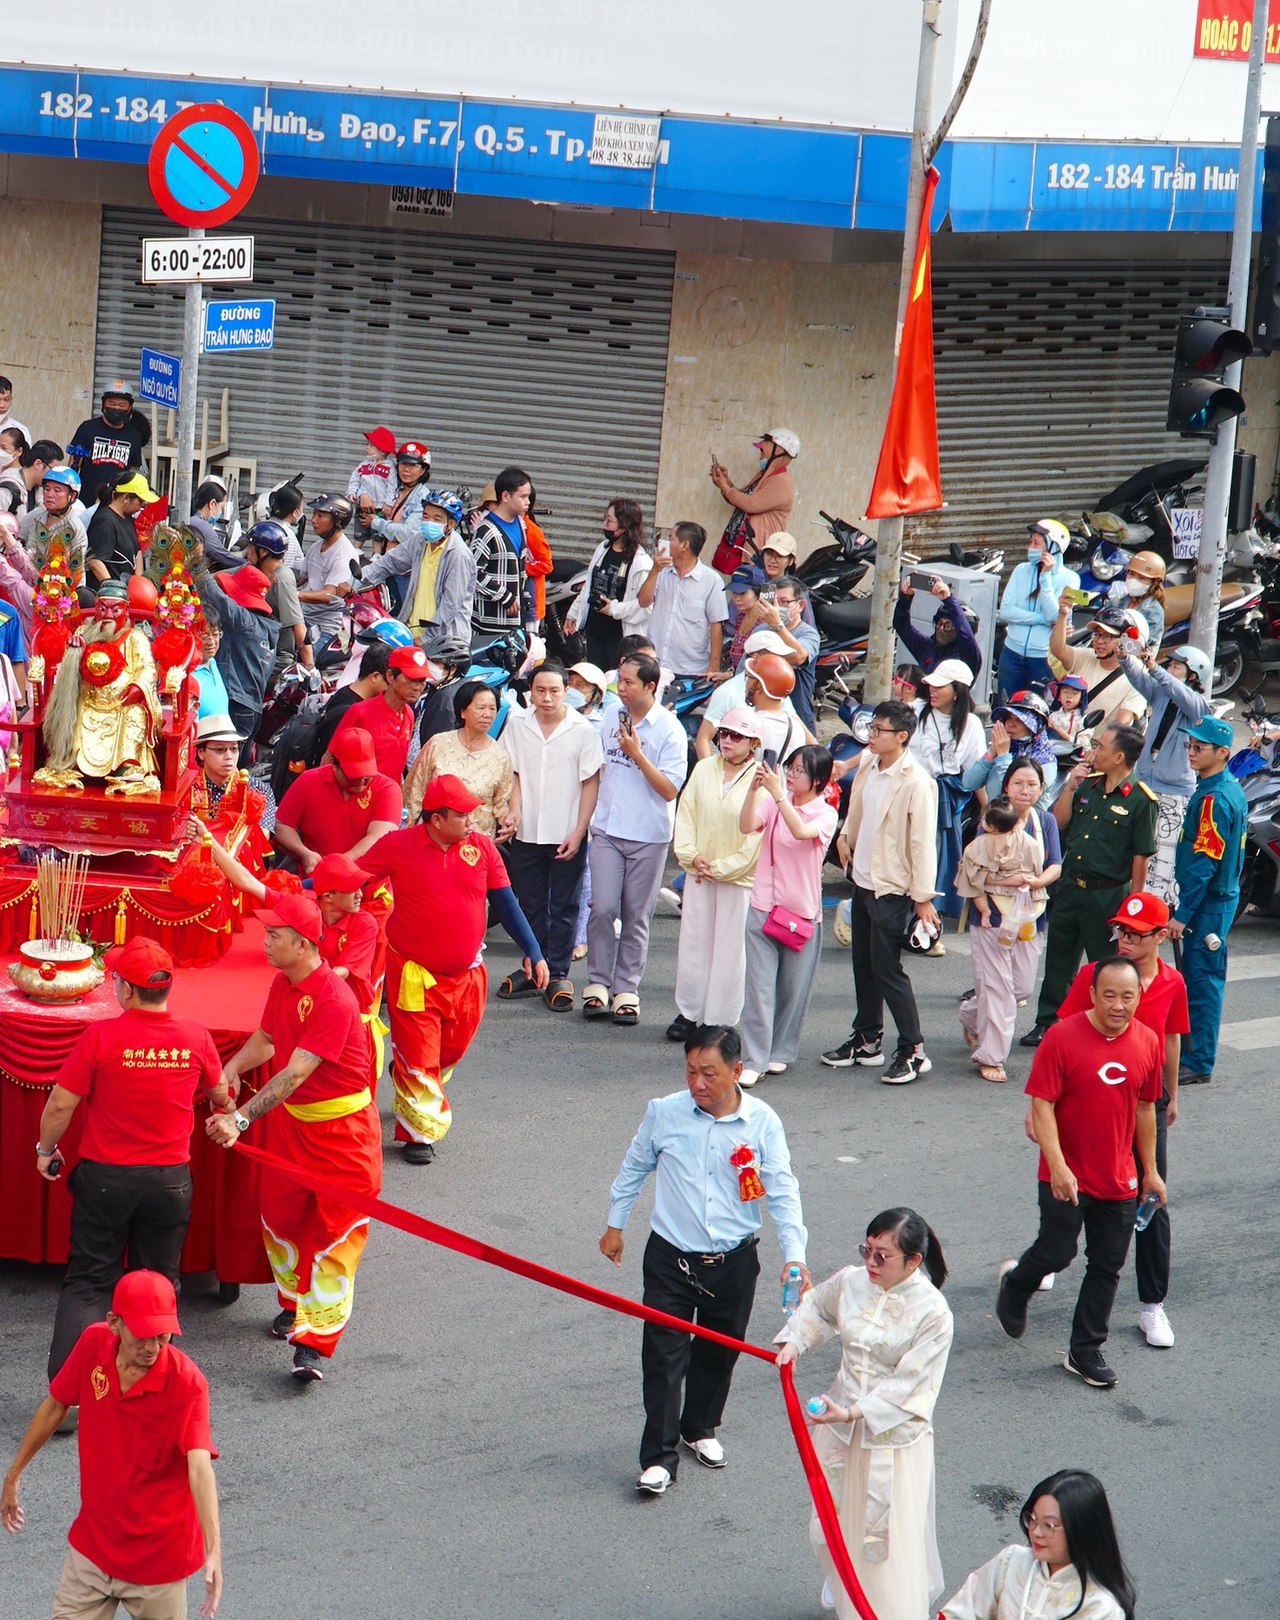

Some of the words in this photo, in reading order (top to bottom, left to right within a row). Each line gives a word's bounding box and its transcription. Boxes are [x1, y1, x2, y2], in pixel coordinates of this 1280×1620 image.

[1200, 14, 1239, 56] HOẶC
[596, 117, 612, 132] LIÊN
[624, 119, 646, 135] CHÍNH
[340, 114, 405, 148] Đạo,
[413, 119, 465, 149] F.7,
[475, 125, 537, 155] Q.5.
[546, 130, 592, 162] Tp.
[628, 139, 644, 152] XEM
[1151, 162, 1196, 190] Trần
[1204, 166, 1240, 191] Hưn
[396, 205, 419, 213] ANH
[221, 306, 261, 320] ĐƯỜNG
[206, 325, 228, 346] TRẦN
[230, 327, 253, 344] HƯNG
[254, 327, 272, 346] ĐẠO
[149, 357, 173, 376] ĐƯỜNG
[142, 376, 155, 395] NGÔ
[156, 380, 178, 402] QUYỀN
[92, 443, 130, 466] HILFIGER
[122, 1060, 135, 1068] HỘI
[158, 1060, 179, 1068] NGHĨA
